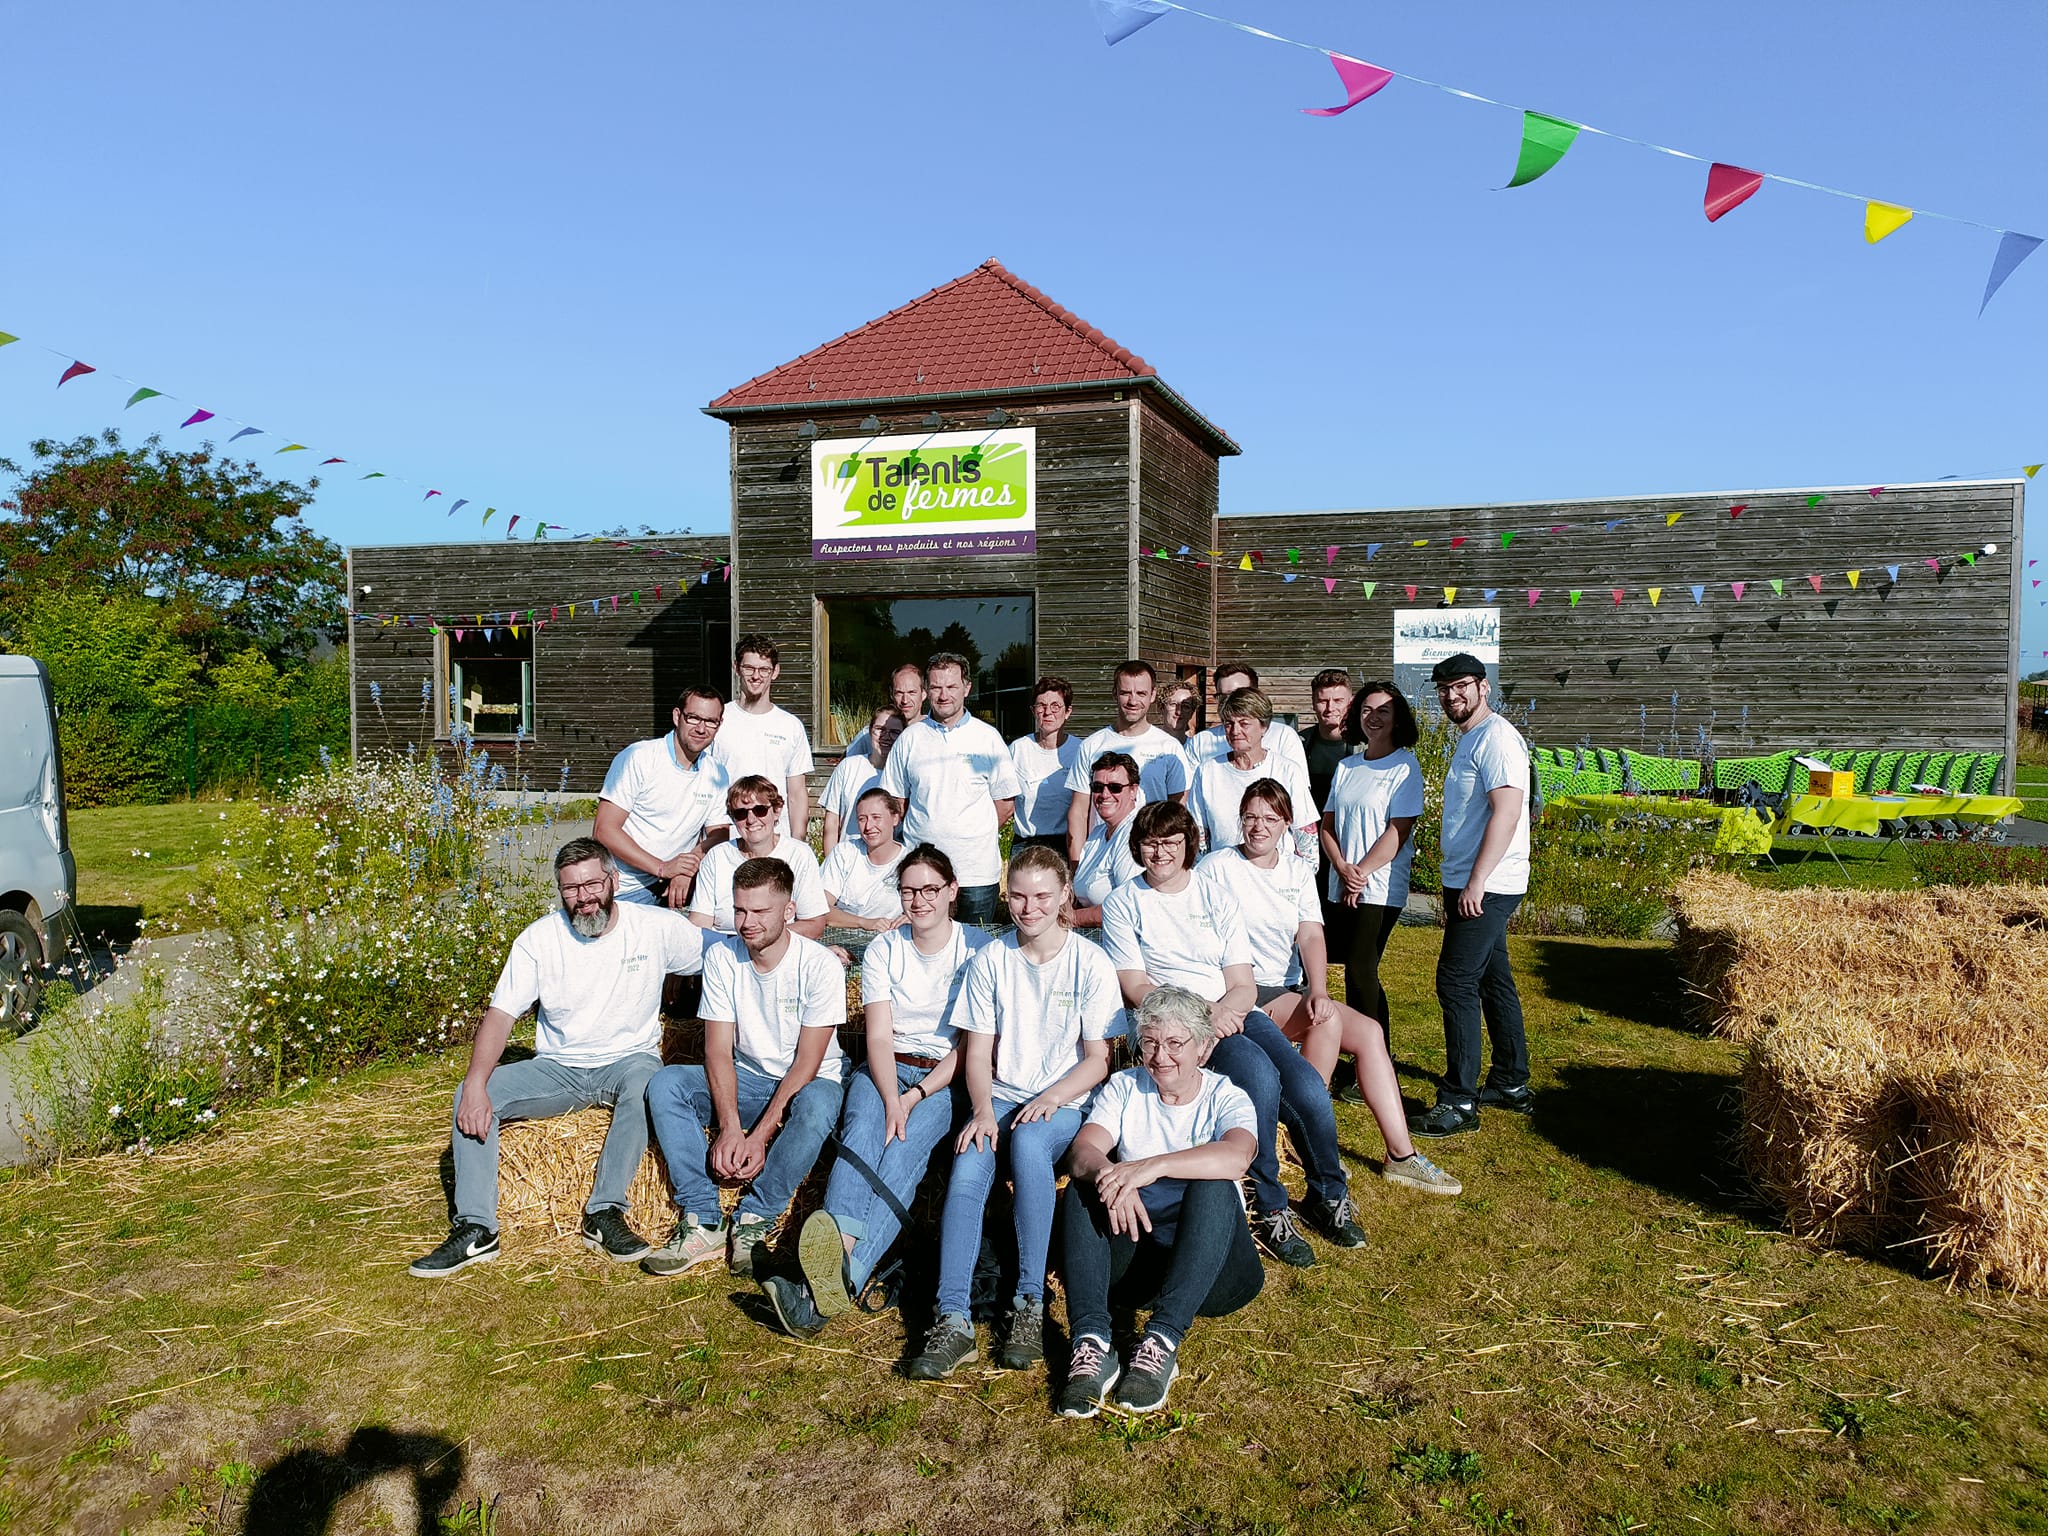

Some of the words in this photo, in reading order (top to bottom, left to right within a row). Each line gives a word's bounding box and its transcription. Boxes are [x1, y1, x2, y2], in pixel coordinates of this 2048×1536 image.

[865, 455, 981, 488] Talents
[868, 490, 897, 512] de
[901, 479, 1016, 521] fermes
[820, 543, 872, 554] Respectons
[876, 543, 893, 551] nos
[896, 539, 940, 553] produits
[943, 541, 953, 549] et
[956, 539, 975, 548] nos
[978, 536, 1017, 549] régions
